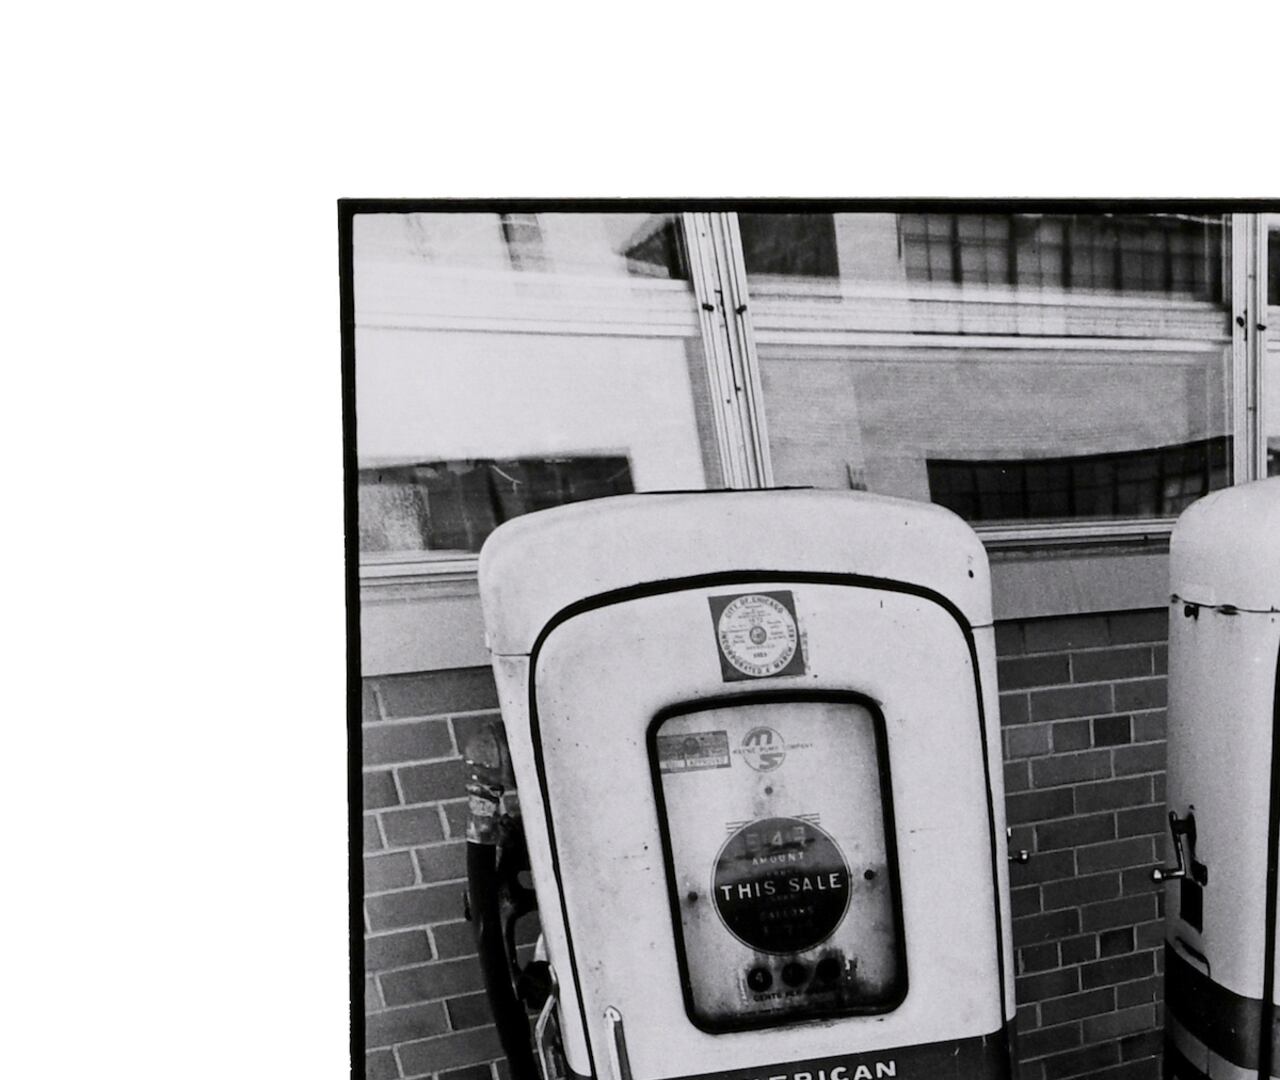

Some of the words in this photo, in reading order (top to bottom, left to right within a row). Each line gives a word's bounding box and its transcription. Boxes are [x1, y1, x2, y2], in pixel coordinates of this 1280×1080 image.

[752, 597, 784, 614] CHICAGO
[752, 852, 804, 865] AMOUNT
[720, 880, 776, 901] THIS
[788, 873, 842, 892] SALE
